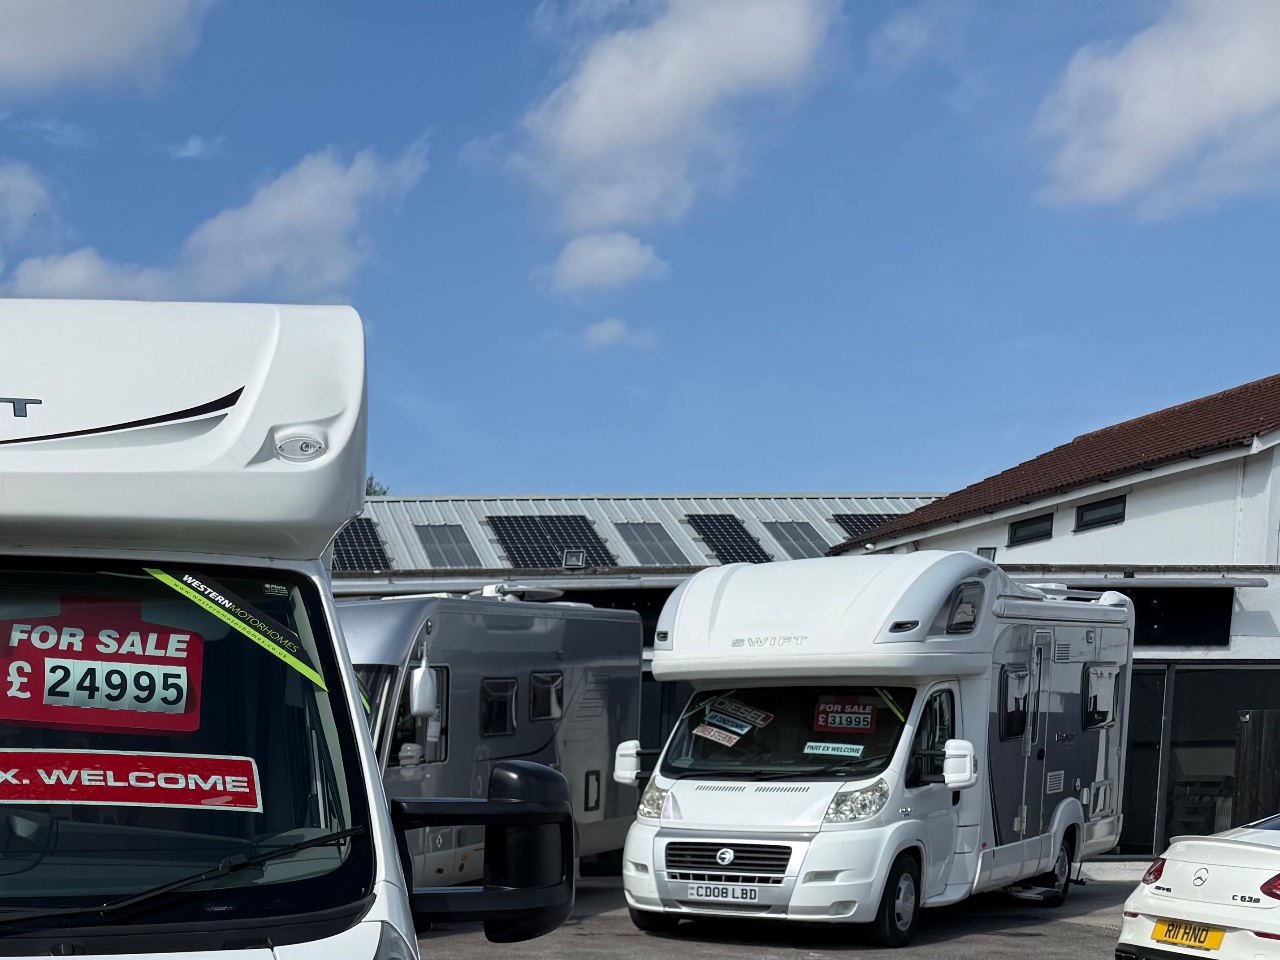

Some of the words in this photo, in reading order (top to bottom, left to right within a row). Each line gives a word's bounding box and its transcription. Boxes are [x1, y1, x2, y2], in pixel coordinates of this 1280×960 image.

[174, 583, 287, 659] www.westernmotorhomes.co.uk
[182, 574, 299, 653] WESTERNMOTORHOMES
[9, 624, 84, 651] FOR
[96, 629, 190, 658] SALE
[731, 636, 807, 647] SWIFT
[6, 660, 32, 699] £
[47, 664, 184, 705] 24995
[713, 699, 766, 725] DIESEL
[818, 714, 826, 725] £
[829, 715, 870, 727] 31995
[819, 704, 841, 712] FOR
[844, 705, 873, 713] SALE
[806, 744, 821, 752] PART
[831, 745, 861, 754] WELCOME
[37, 769, 250, 793] WELCOME
[696, 886, 728, 898] CD08
[732, 888, 757, 900] LBD
